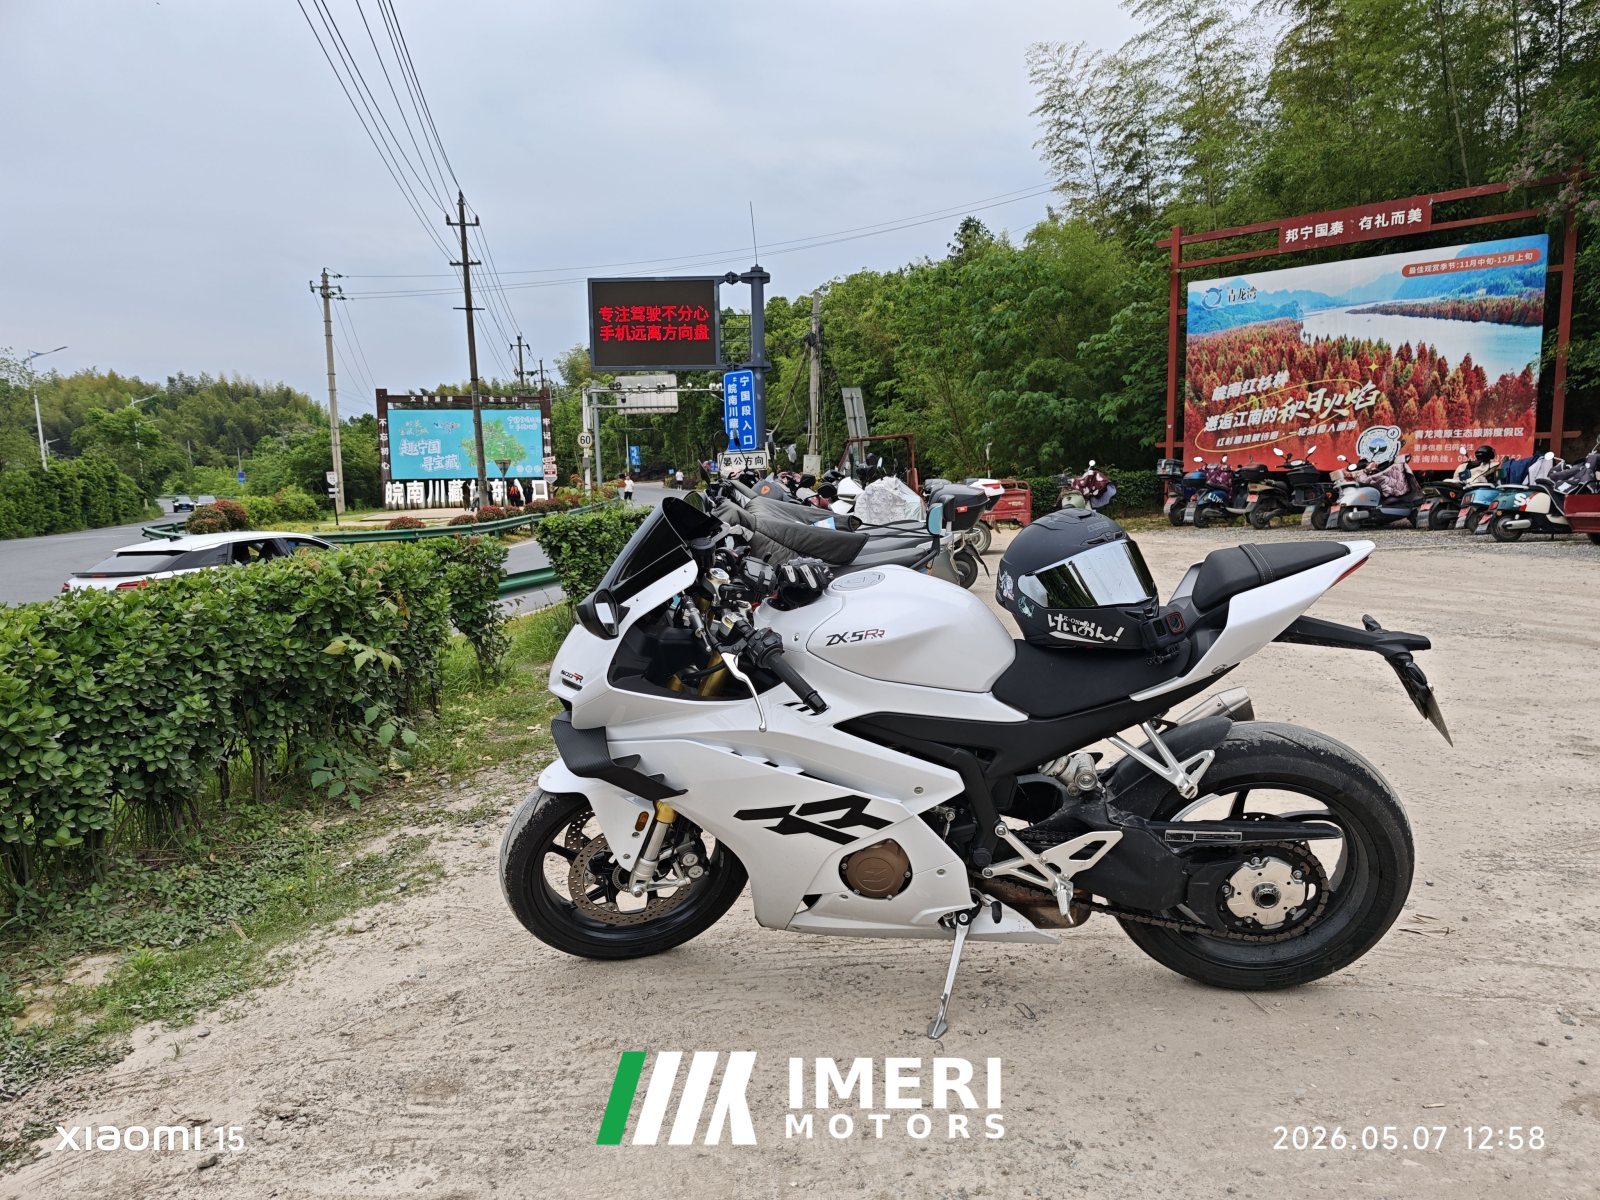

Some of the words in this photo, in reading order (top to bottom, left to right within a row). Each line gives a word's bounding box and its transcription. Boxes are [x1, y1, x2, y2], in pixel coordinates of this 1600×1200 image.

[1285, 221, 1344, 243] 邦宁国泰
[1359, 208, 1422, 231] 有礼而美
[599, 305, 710, 323] 专注驾驶不分心
[599, 325, 710, 342] 手机远离方向盘
[740, 376, 753, 445] 宁国段入口
[399, 439, 442, 456] 趣宁国
[580, 436, 591, 445] 60
[422, 454, 461, 472] 寻宝藏
[385, 479, 549, 506] 皖南川藏东入口
